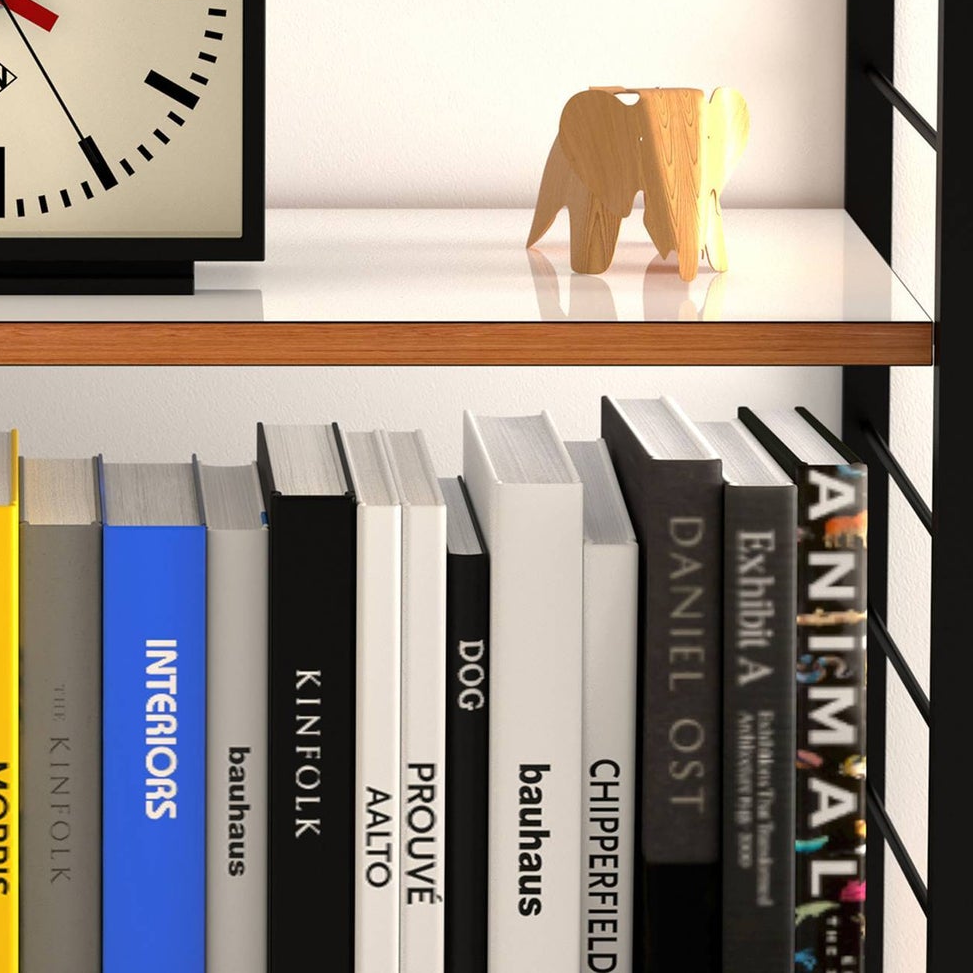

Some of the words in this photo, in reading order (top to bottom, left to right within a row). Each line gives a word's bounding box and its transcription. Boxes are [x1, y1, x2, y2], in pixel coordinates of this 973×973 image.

[668, 516, 705, 691] DANIEL
[737, 530, 775, 648] Exhibit
[53, 684, 66, 722] THE
[145, 639, 178, 820] INTERIORS
[457, 639, 485, 711] DOG
[737, 657, 773, 686] A
[49, 737, 71, 884] KINFOLK
[228, 746, 251, 877] bauhaus
[295, 670, 322, 838] KINFOLK
[668, 717, 706, 814] OST
[365, 786, 392, 888] AALTO
[406, 763, 442, 905] PROUVÉ
[518, 763, 551, 917] bauhaus
[587, 759, 621, 973] CHIPPERFIELD
